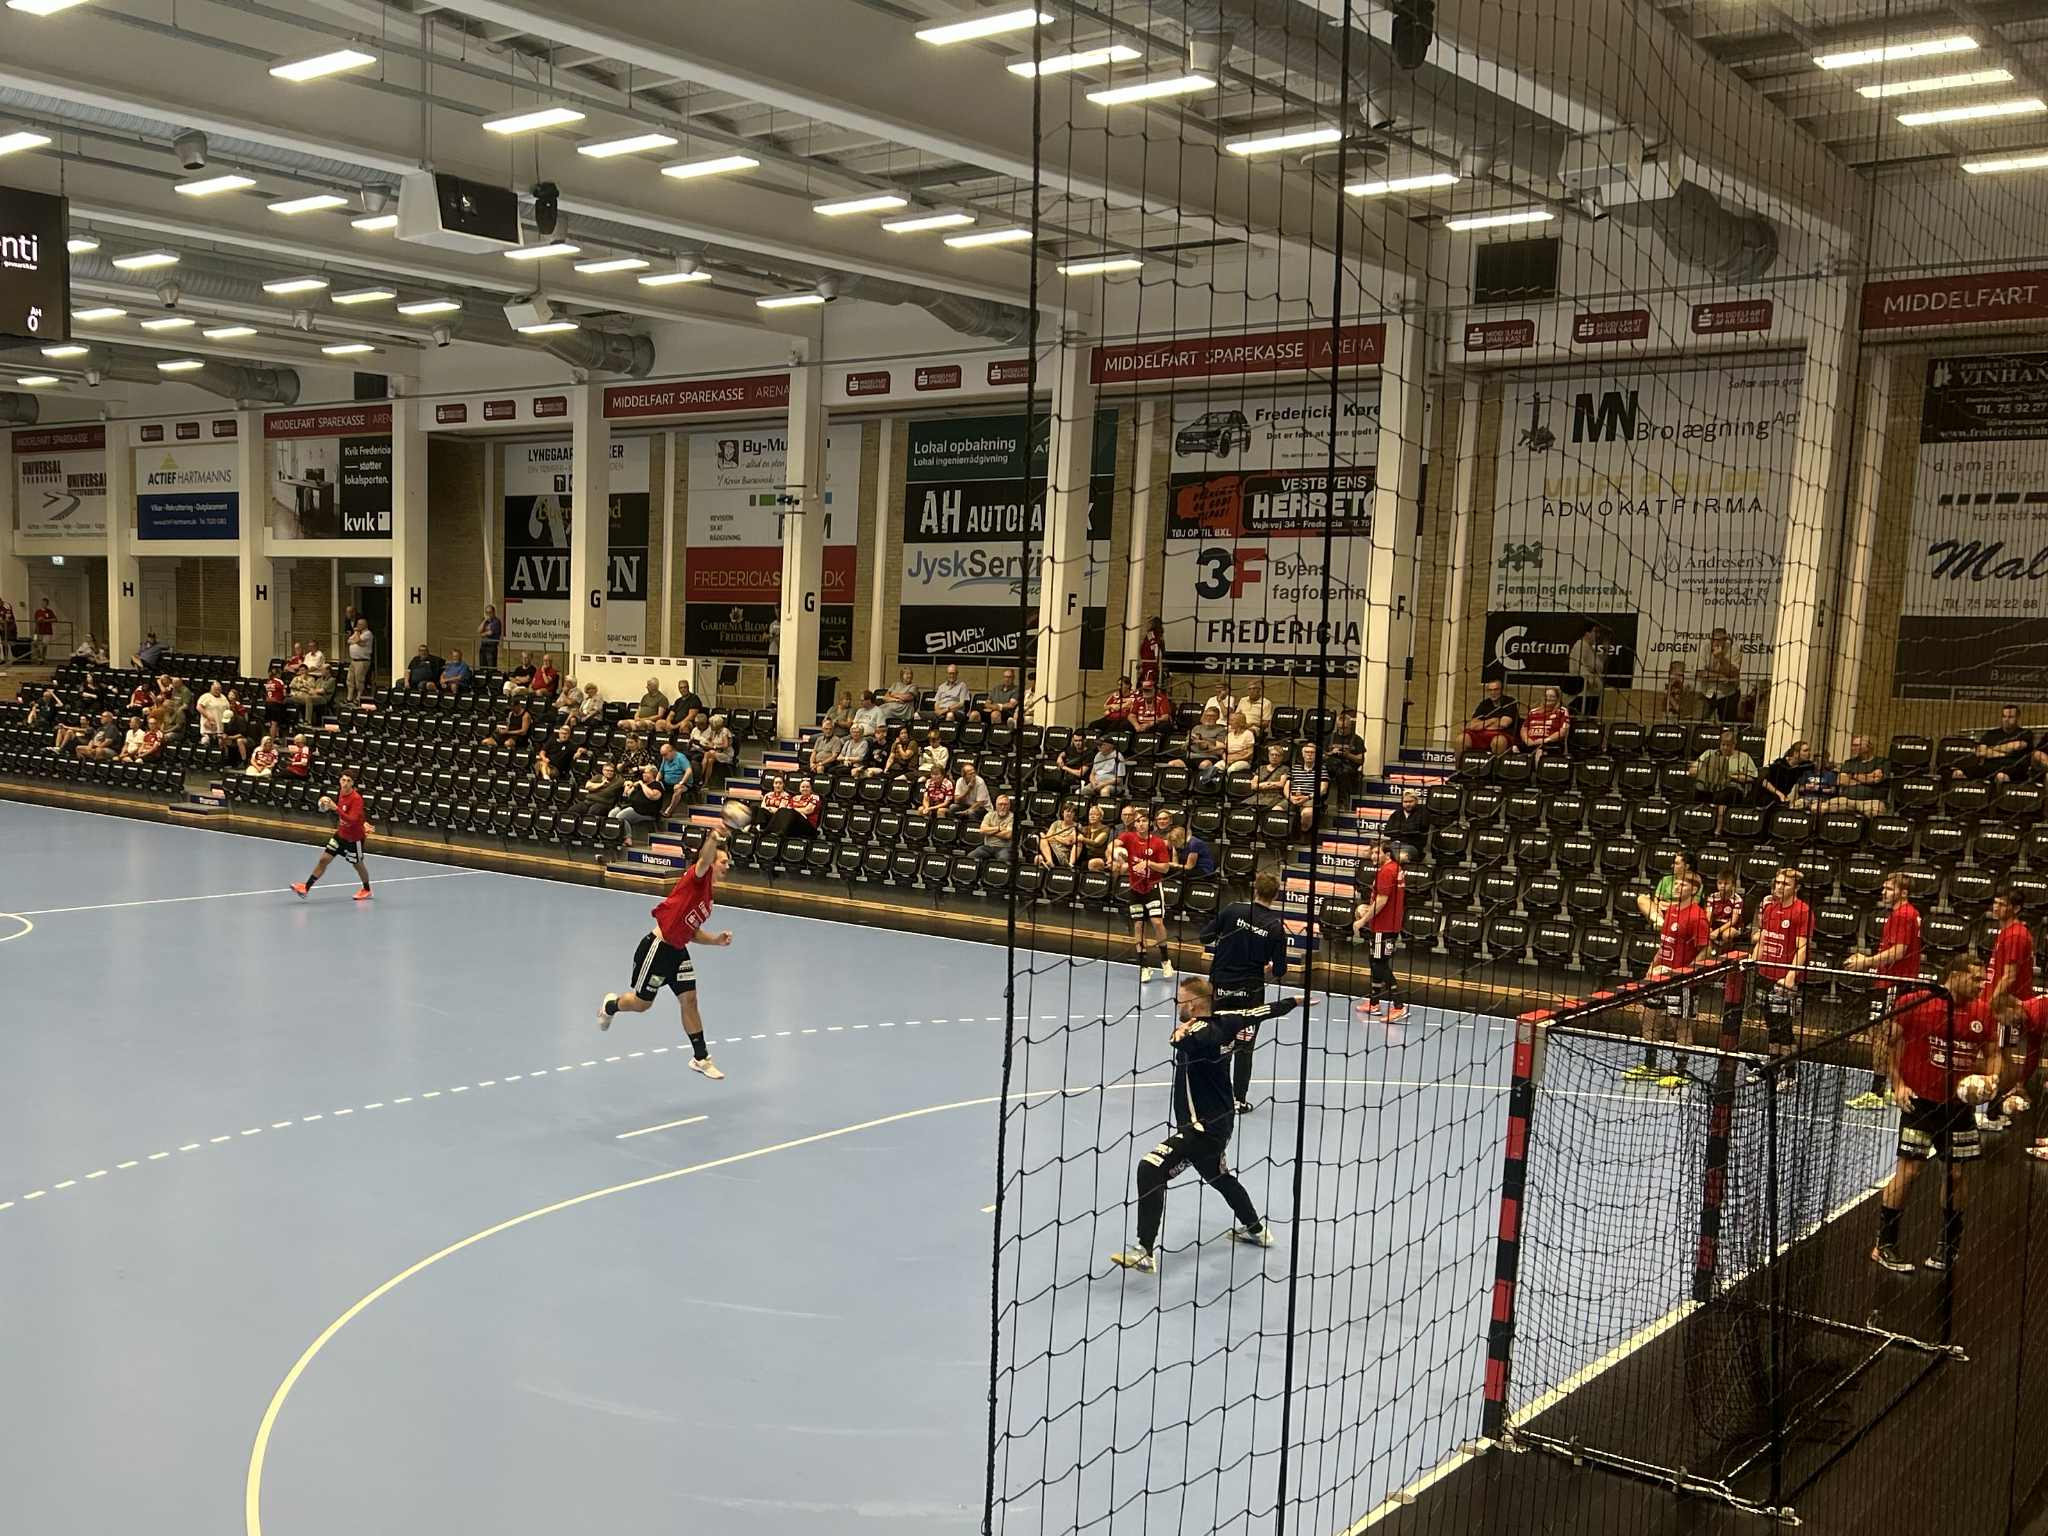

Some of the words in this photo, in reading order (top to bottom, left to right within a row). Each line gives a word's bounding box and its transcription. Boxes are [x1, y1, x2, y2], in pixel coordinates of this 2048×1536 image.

[1884, 285, 2039, 315] MIDDELFART
[1104, 351, 1197, 372] MIDDELFART
[1205, 342, 1304, 365] SPAREKASSE
[1321, 337, 1375, 356] ARENA
[612, 393, 675, 410] MIDDELFART
[679, 387, 745, 405] SPAREKASSE
[270, 418, 315, 431] MIDDELFART
[318, 415, 365, 428] SPAREKASSE
[914, 440, 947, 454] Lokal
[950, 437, 1017, 454] opbakning
[1543, 497, 1763, 518] ADVOKATFIRMA
[344, 512, 375, 532] kvik
[1284, 519, 1295, 529] 34
[1187, 527, 1199, 539] OP
[1195, 547, 1267, 600] 3F
[123, 582, 134, 597] H
[256, 584, 267, 601] H
[411, 587, 422, 604] H
[590, 589, 602, 608] G
[804, 592, 816, 612] G
[1068, 593, 1078, 616] F
[1397, 595, 1407, 620] F
[925, 626, 985, 654] SIMPLY
[1207, 620, 1361, 645] FREDERICIA
[955, 633, 1019, 655] COOKING
[642, 854, 672, 868] thansen
